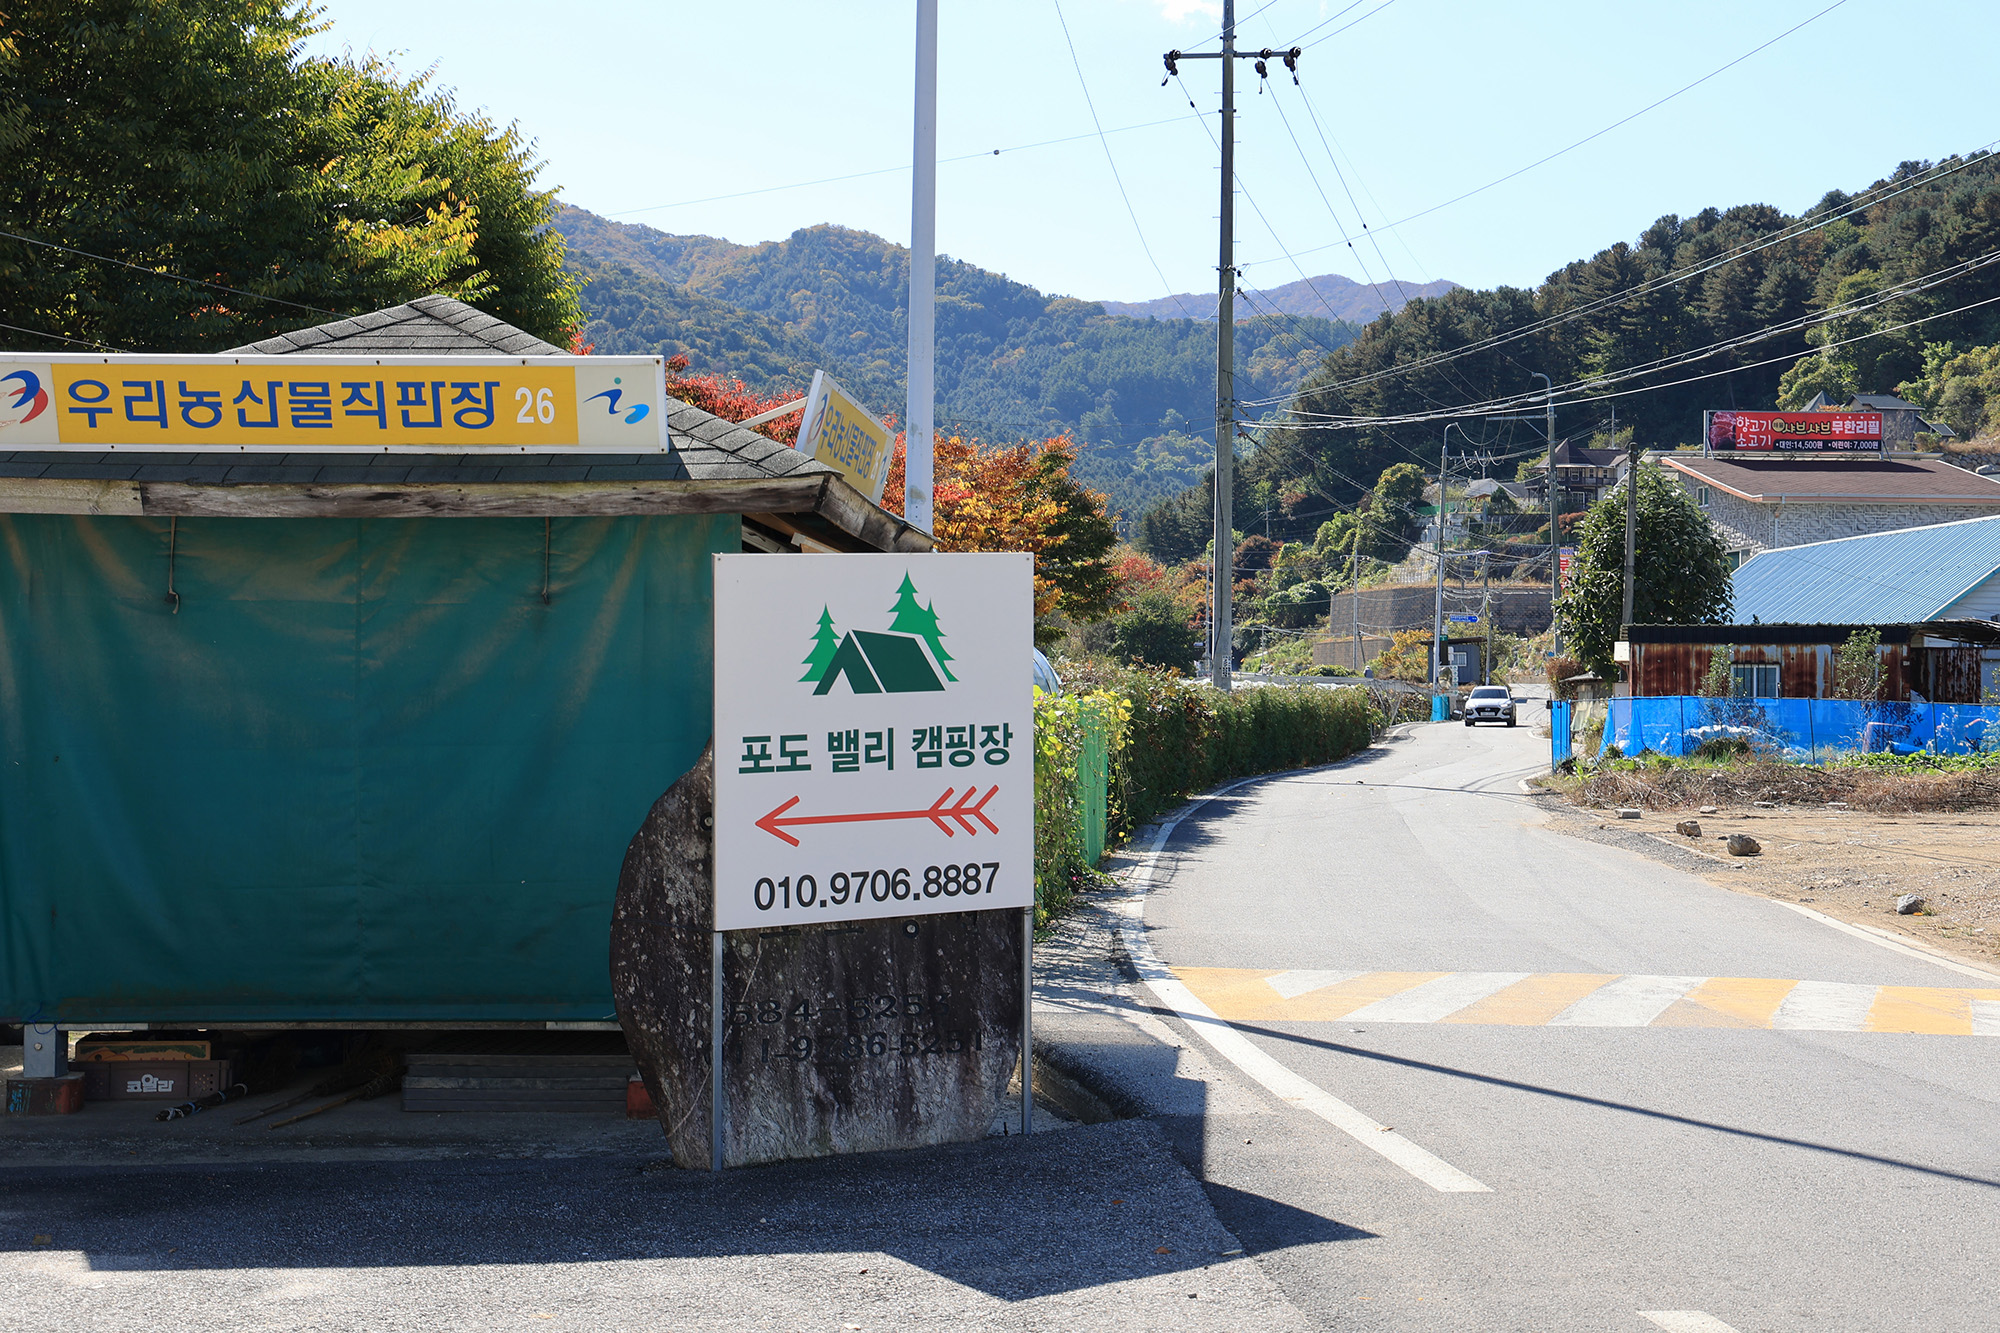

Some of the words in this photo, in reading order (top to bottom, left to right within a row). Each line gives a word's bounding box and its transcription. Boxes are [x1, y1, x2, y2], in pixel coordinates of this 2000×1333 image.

[66, 380, 501, 430] 우리농산물직판장
[515, 387, 556, 425] 26
[1782, 421, 1832, 435] 샤브샤브
[1832, 420, 1880, 434] 무한리필
[820, 405, 878, 479] 우리농산물직판장
[1736, 433, 1772, 447] 소고기
[738, 733, 812, 774] 포도
[826, 727, 895, 773] 밸리
[911, 722, 1014, 769] 캠핑장
[753, 862, 1001, 912] 010.9706.8887
